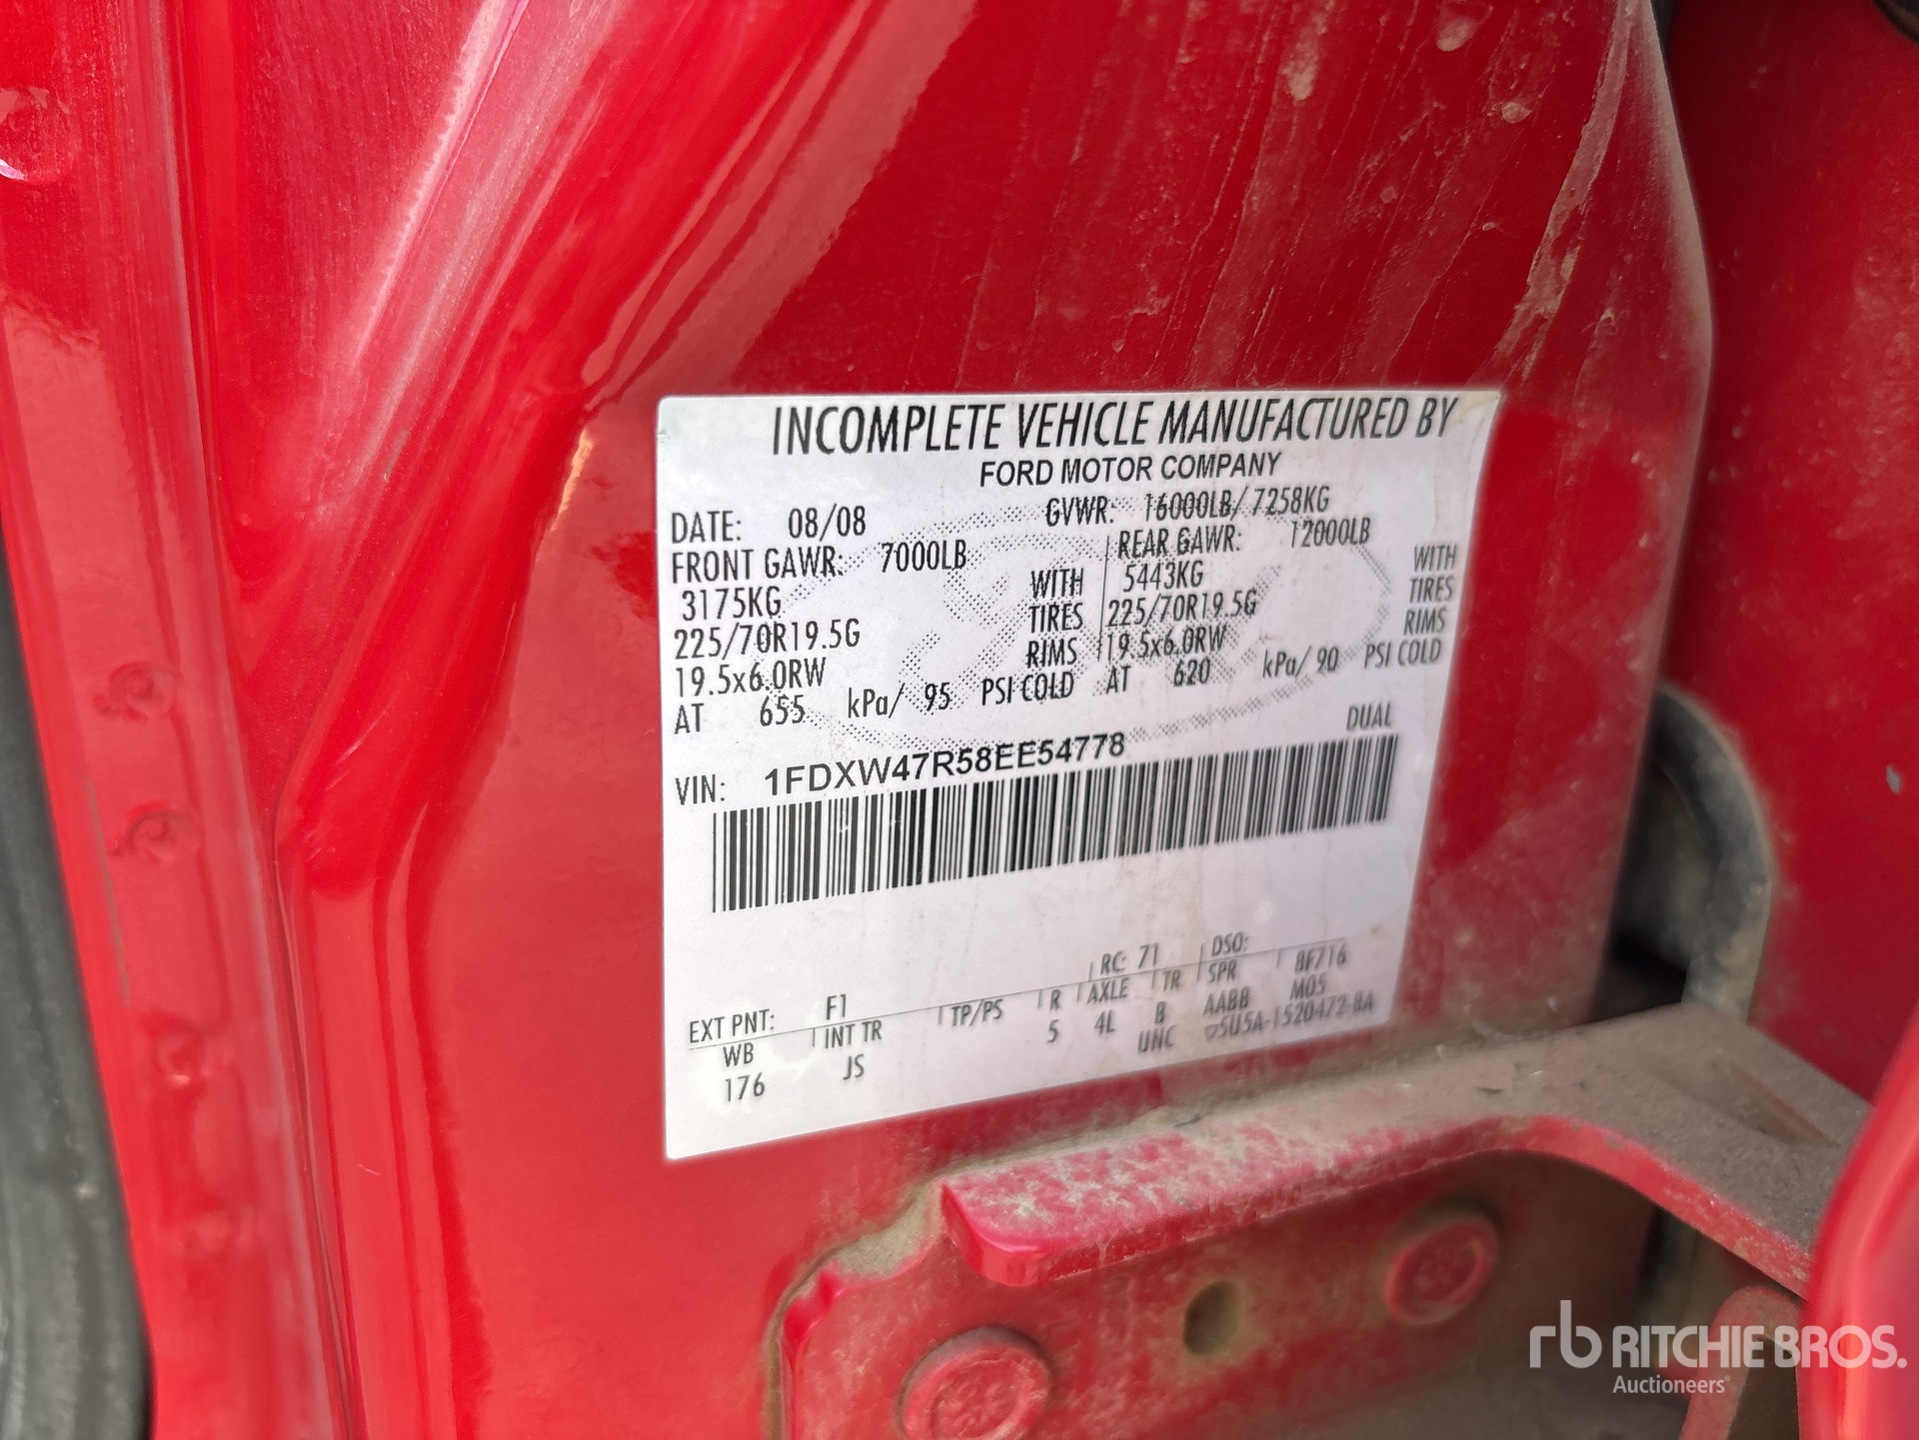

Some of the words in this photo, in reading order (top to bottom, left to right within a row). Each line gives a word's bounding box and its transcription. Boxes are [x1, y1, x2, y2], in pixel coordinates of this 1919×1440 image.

[772, 404, 1005, 455] INCOMPLETE
[1018, 401, 1154, 449] VEHICLE
[1158, 397, 1409, 445] MANUFACTURED
[1415, 397, 1459, 438] BY
[980, 459, 1053, 487] FORD
[1061, 455, 1152, 484] MOTOR
[1161, 451, 1282, 479] COMPANY
[672, 510, 742, 544] DATE:
[787, 503, 866, 542] 08/08
[1045, 495, 1115, 527] GVWR:
[1118, 525, 1169, 559] REAR
[1176, 522, 1242, 556] GAWR:
[1290, 517, 1371, 548] 12000LB
[672, 548, 754, 584] FRONT
[765, 545, 844, 578] GAWR:
[880, 539, 967, 573] 7000LB
[1414, 544, 1457, 572] WITH
[1031, 568, 1084, 600] WITH
[1123, 560, 1204, 592] 5443KG
[1409, 576, 1453, 604] TIRES
[681, 586, 782, 621] 3175KG
[1028, 603, 1083, 633] TIRES
[1107, 589, 1257, 628] 225/70R19.5G
[1403, 607, 1447, 636] RIMS
[674, 618, 860, 660] 225/70R19.5G
[1026, 638, 1078, 668] RIMS
[1106, 624, 1227, 661] 19.5x6.0RW
[676, 657, 826, 697] 19.5x6.0RW
[1106, 665, 1131, 695] AT
[1173, 658, 1211, 687] 620
[1263, 646, 1313, 679] kPa/
[1317, 646, 1339, 673] 90
[1364, 642, 1391, 670] PSI
[1397, 638, 1441, 666] COLD
[674, 703, 704, 734] AT
[760, 695, 805, 726] 655
[848, 683, 905, 719] kPa/
[924, 682, 951, 711] 95
[982, 675, 1012, 705] PSI
[1022, 672, 1074, 701] COLD
[1346, 703, 1392, 731] DUAL
[675, 774, 726, 806] VIN:
[765, 732, 1125, 796] 1FDXW47R58EE54778
[1212, 931, 1248, 956] DSO:
[1295, 943, 1347, 973] 8F716
[1101, 951, 1127, 975] RC:
[1138, 943, 1159, 968] 71
[1208, 959, 1237, 983] SPR
[1087, 977, 1130, 1004] AXLE
[1163, 969, 1181, 991] TR
[951, 999, 1003, 1028] TP/PS
[1050, 989, 1061, 1010] R
[1203, 986, 1250, 1016] AABB
[689, 1016, 725, 1045] EXT
[731, 1009, 775, 1039] PNT:
[826, 994, 848, 1020] F1
[824, 1024, 855, 1049] INT
[861, 1019, 882, 1042] TR
[1047, 1019, 1060, 1044] 5
[1094, 1010, 1116, 1036] 4L
[722, 1041, 755, 1067] WB
[1138, 1024, 1176, 1054] UNC
[843, 1053, 865, 1080] JS
[724, 1072, 766, 1102] 176
